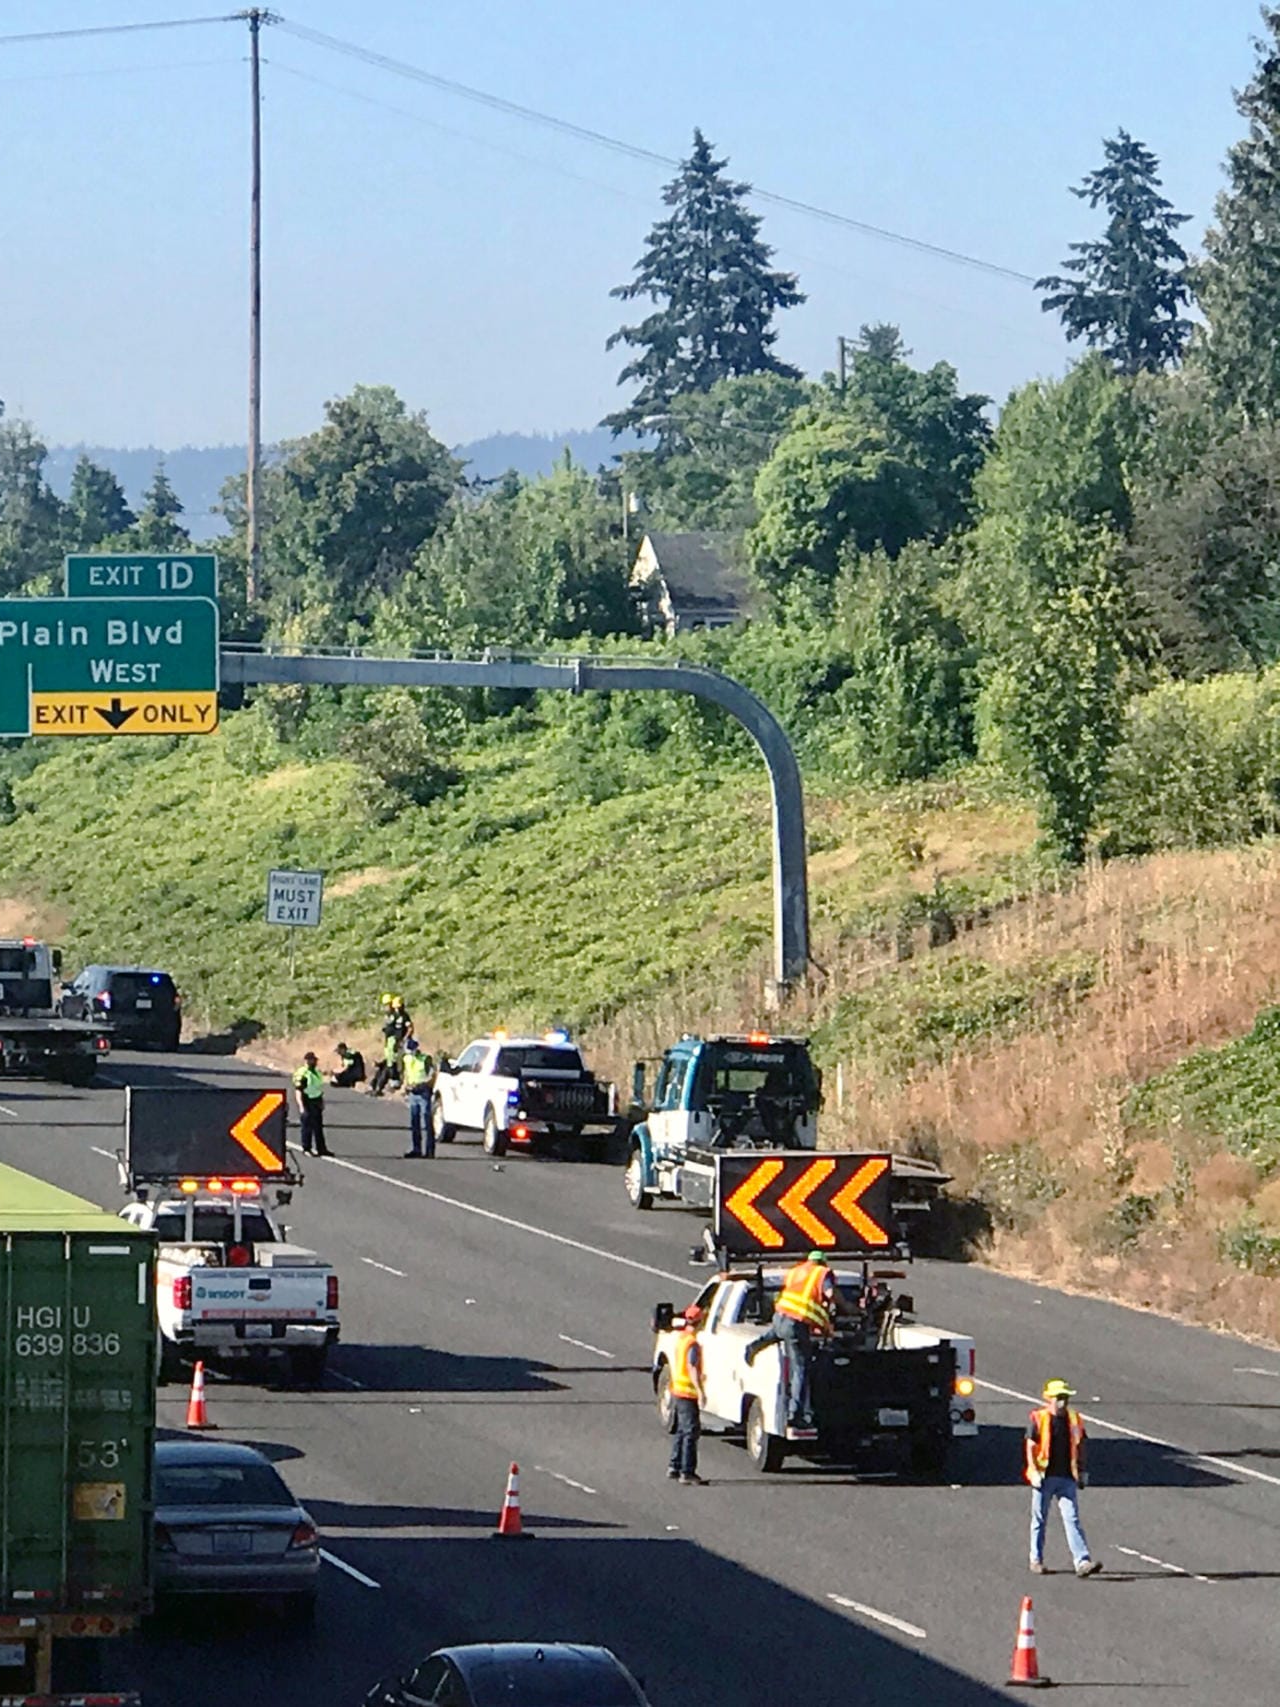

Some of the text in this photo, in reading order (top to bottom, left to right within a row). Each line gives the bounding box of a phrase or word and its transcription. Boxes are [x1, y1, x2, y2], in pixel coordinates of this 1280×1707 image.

[89, 562, 194, 589] EXIT 1D
[107, 620, 183, 645] Blvd
[91, 659, 161, 683] WEST
[36, 704, 211, 724] EXIT ONLY
[274, 889, 315, 903] MUST
[277, 906, 309, 920] EXIT
